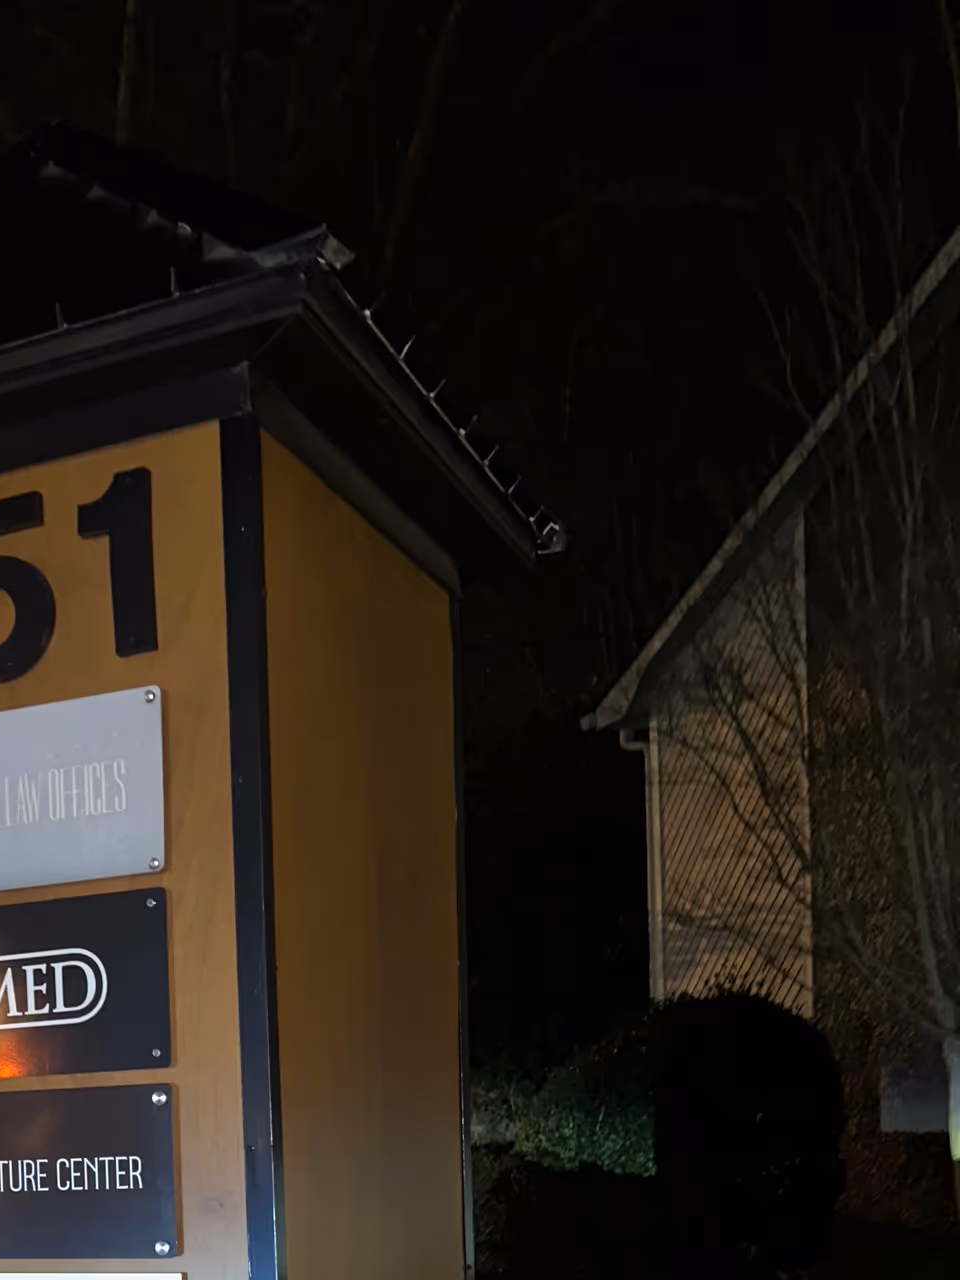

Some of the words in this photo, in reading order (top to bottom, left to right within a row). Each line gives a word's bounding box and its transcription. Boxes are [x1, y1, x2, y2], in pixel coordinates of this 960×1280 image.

[4, 771, 42, 828] LAW
[48, 759, 127, 821] OFFICES
[56, 1156, 143, 1190] CENTER
